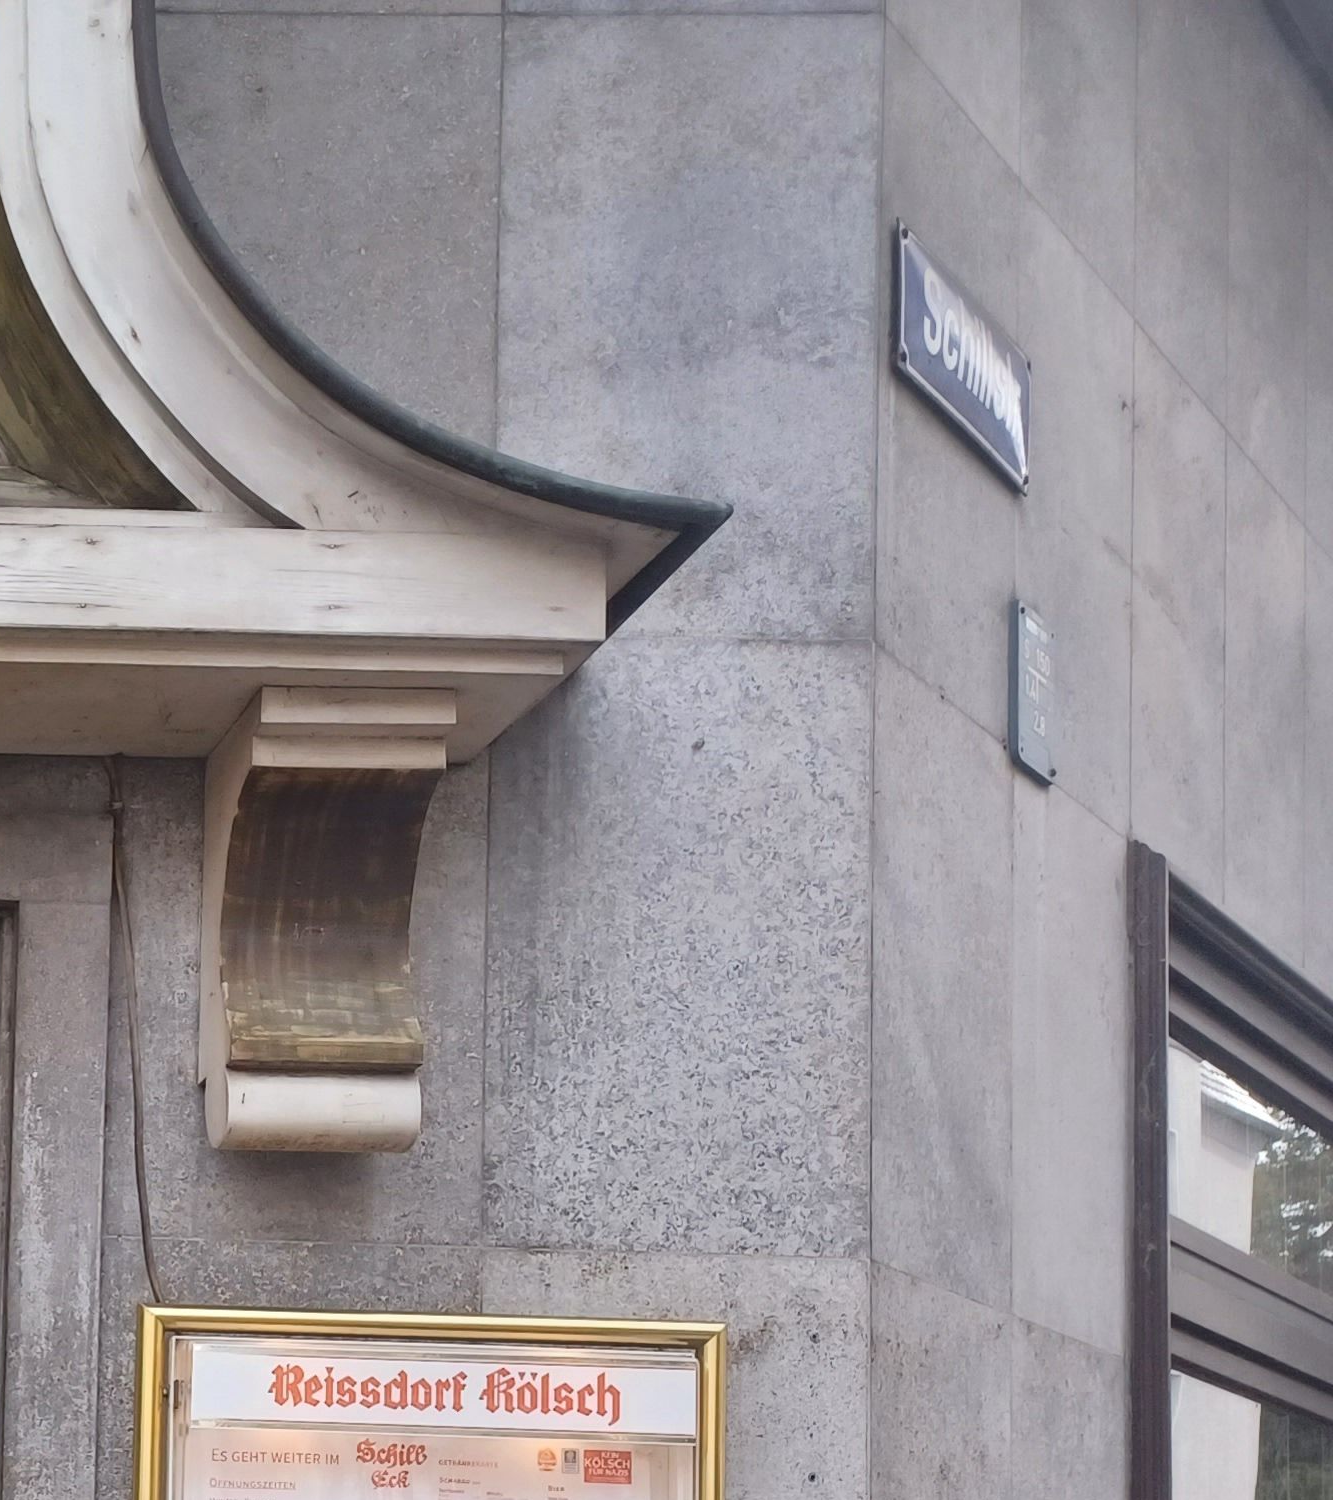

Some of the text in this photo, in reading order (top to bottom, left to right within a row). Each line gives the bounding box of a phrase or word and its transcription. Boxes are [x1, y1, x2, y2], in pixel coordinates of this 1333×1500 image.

[268, 1363, 621, 1426] Reissdorf Kölsch
[232, 1451, 267, 1464] GEHT
[271, 1452, 321, 1465] WEITER
[326, 1453, 340, 1465] IM
[356, 1438, 428, 1468] Schill
[371, 1470, 411, 1489] Eck
